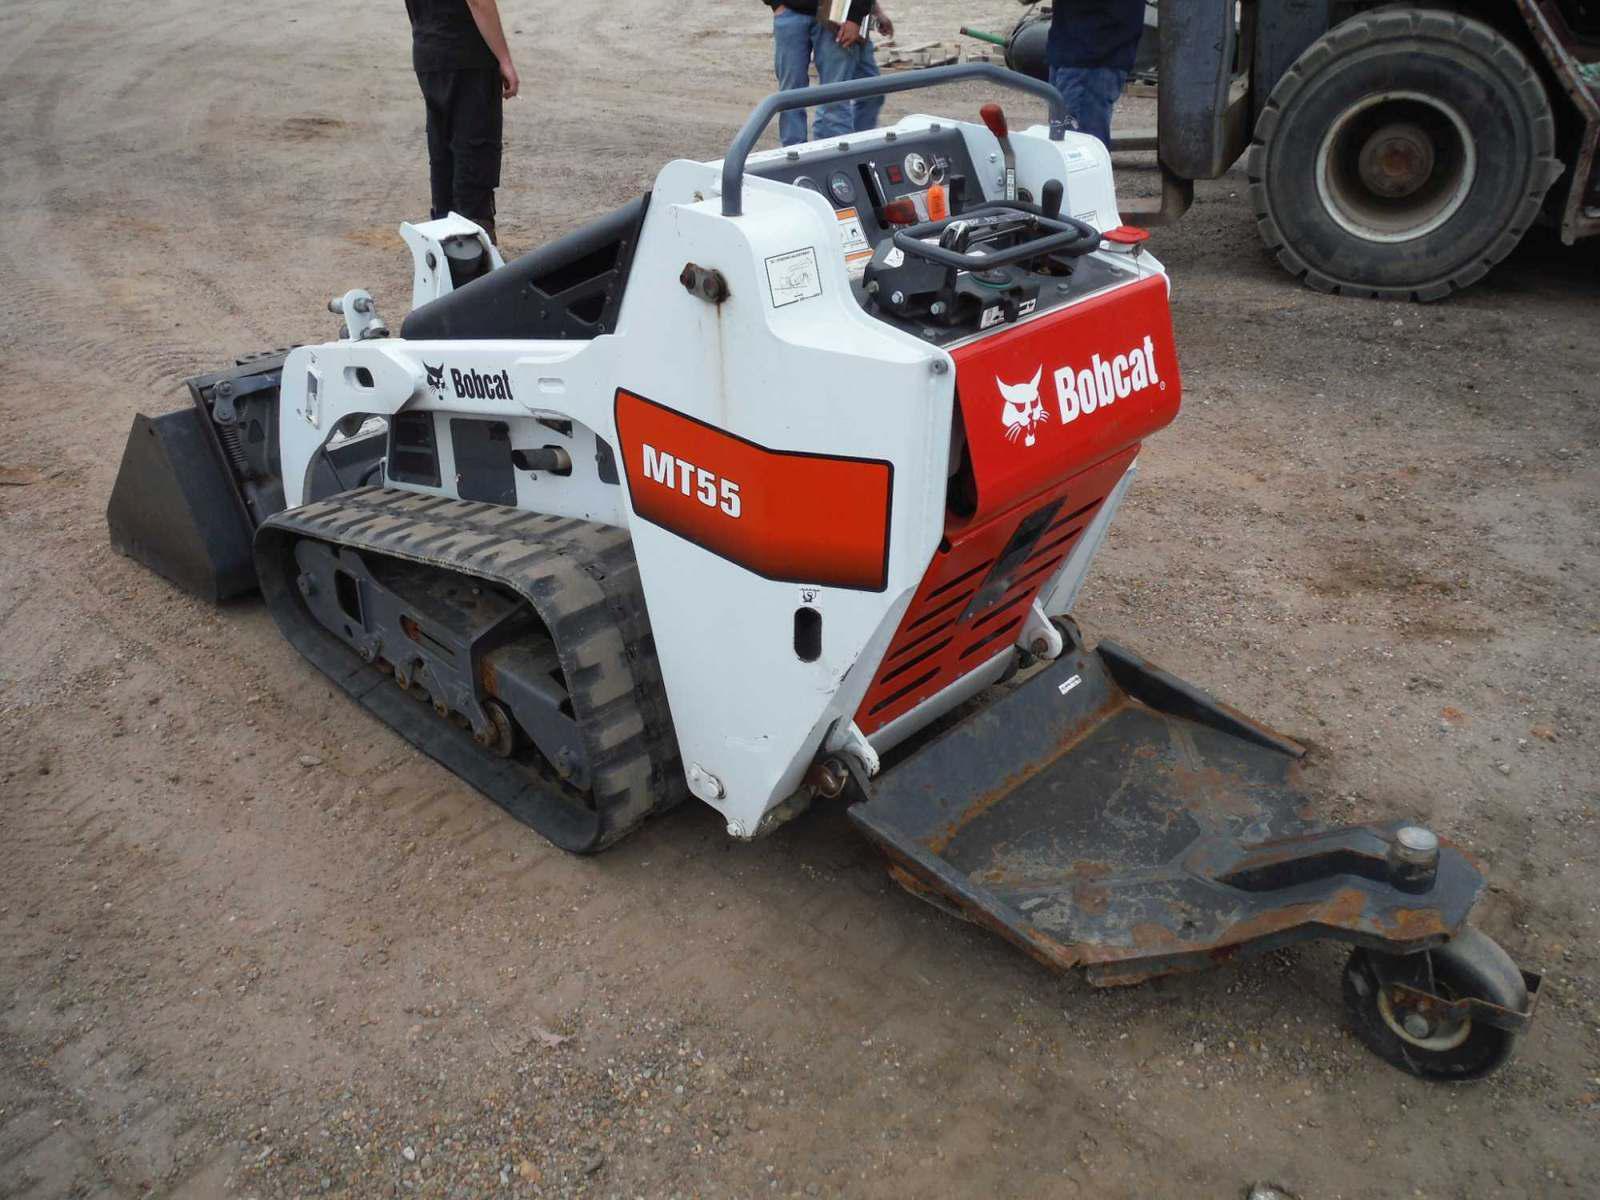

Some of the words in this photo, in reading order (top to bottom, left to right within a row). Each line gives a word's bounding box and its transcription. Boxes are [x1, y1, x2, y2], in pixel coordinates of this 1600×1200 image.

[450, 367, 514, 401] Bobcat
[1053, 335, 1159, 425] Bobcat
[642, 443, 742, 519] MT55
